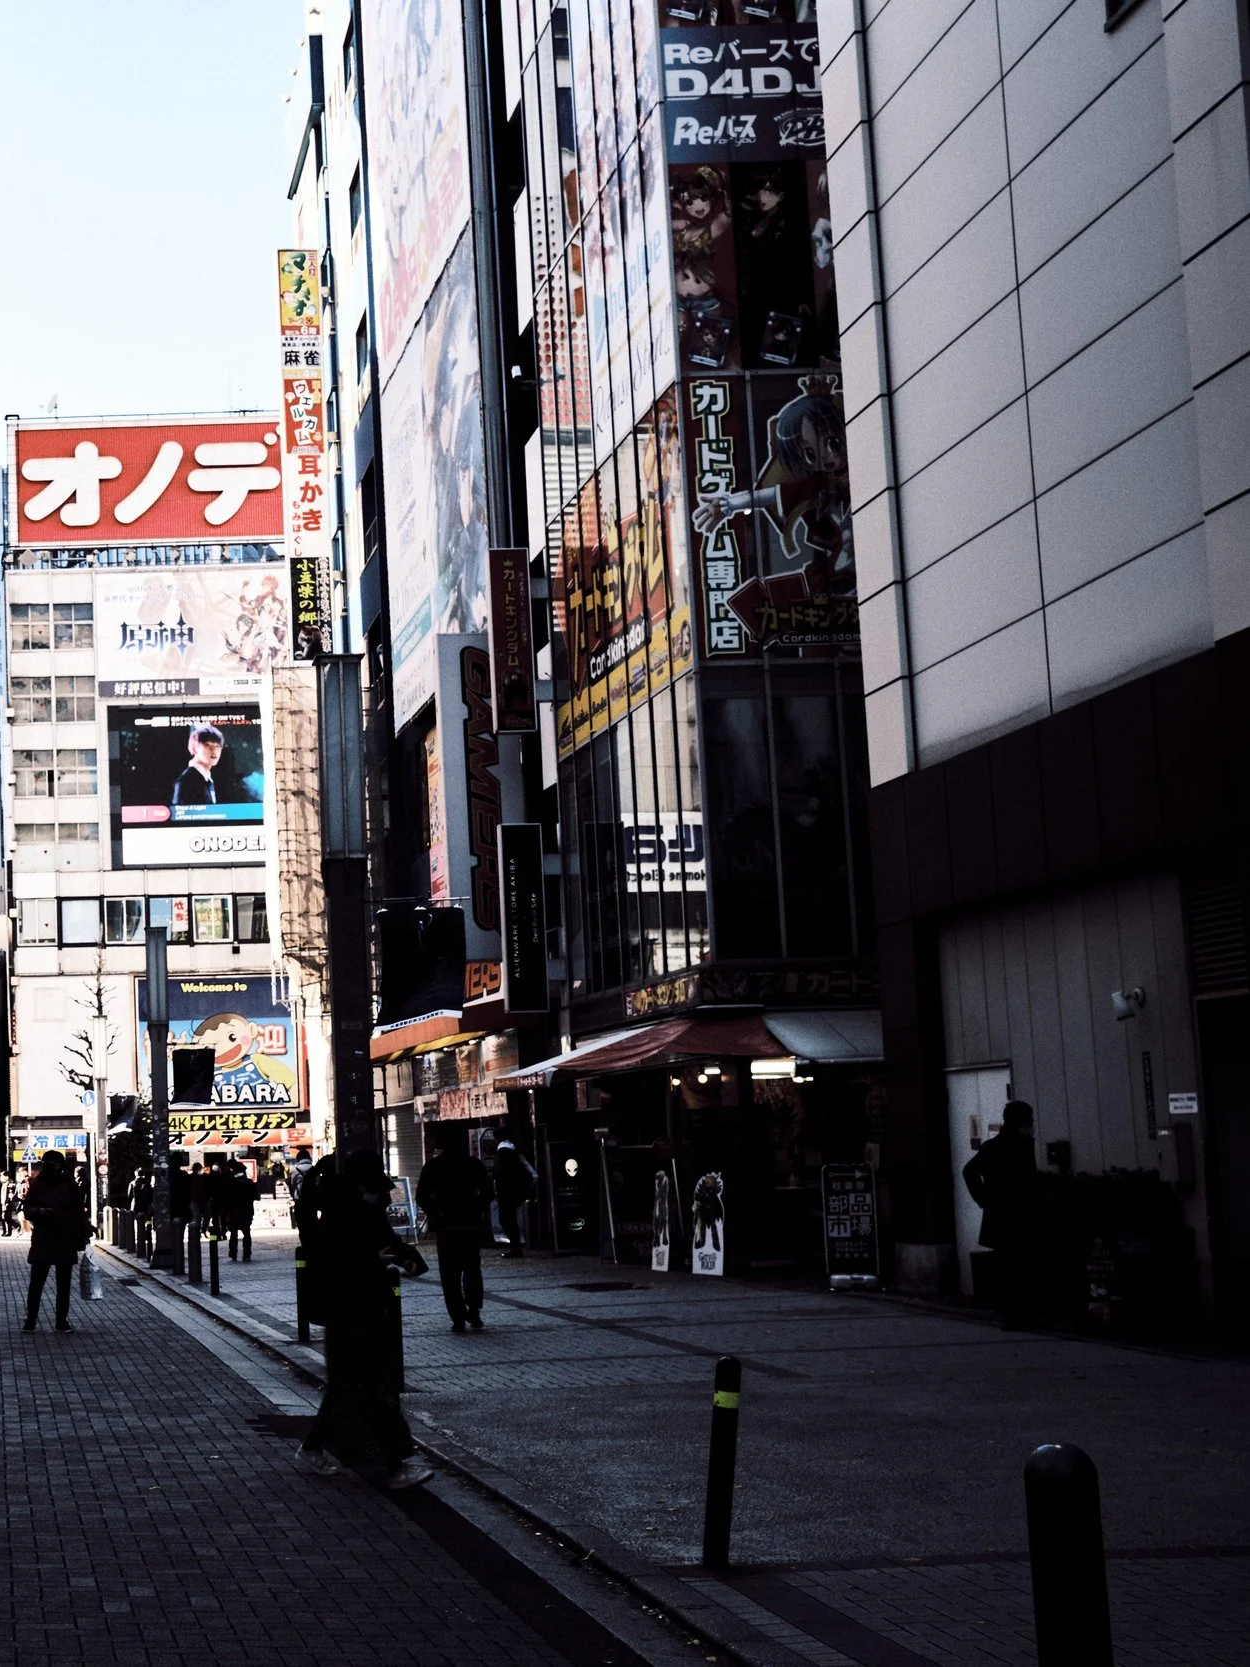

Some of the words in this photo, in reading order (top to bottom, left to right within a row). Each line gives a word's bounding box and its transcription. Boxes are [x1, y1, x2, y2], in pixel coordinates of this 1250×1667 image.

[284, 350, 321, 367] 麻雀
[297, 455, 324, 533] 耳かき
[694, 384, 742, 650] カードゲム専門店
[782, 633, 860, 643] Cardkindom
[460, 646, 502, 932] GAMERS
[181, 983, 230, 993] Welcome
[234, 982, 248, 992] to
[33, 1134, 87, 1149] 冷蔵庫
[169, 1130, 269, 1145] オノデン
